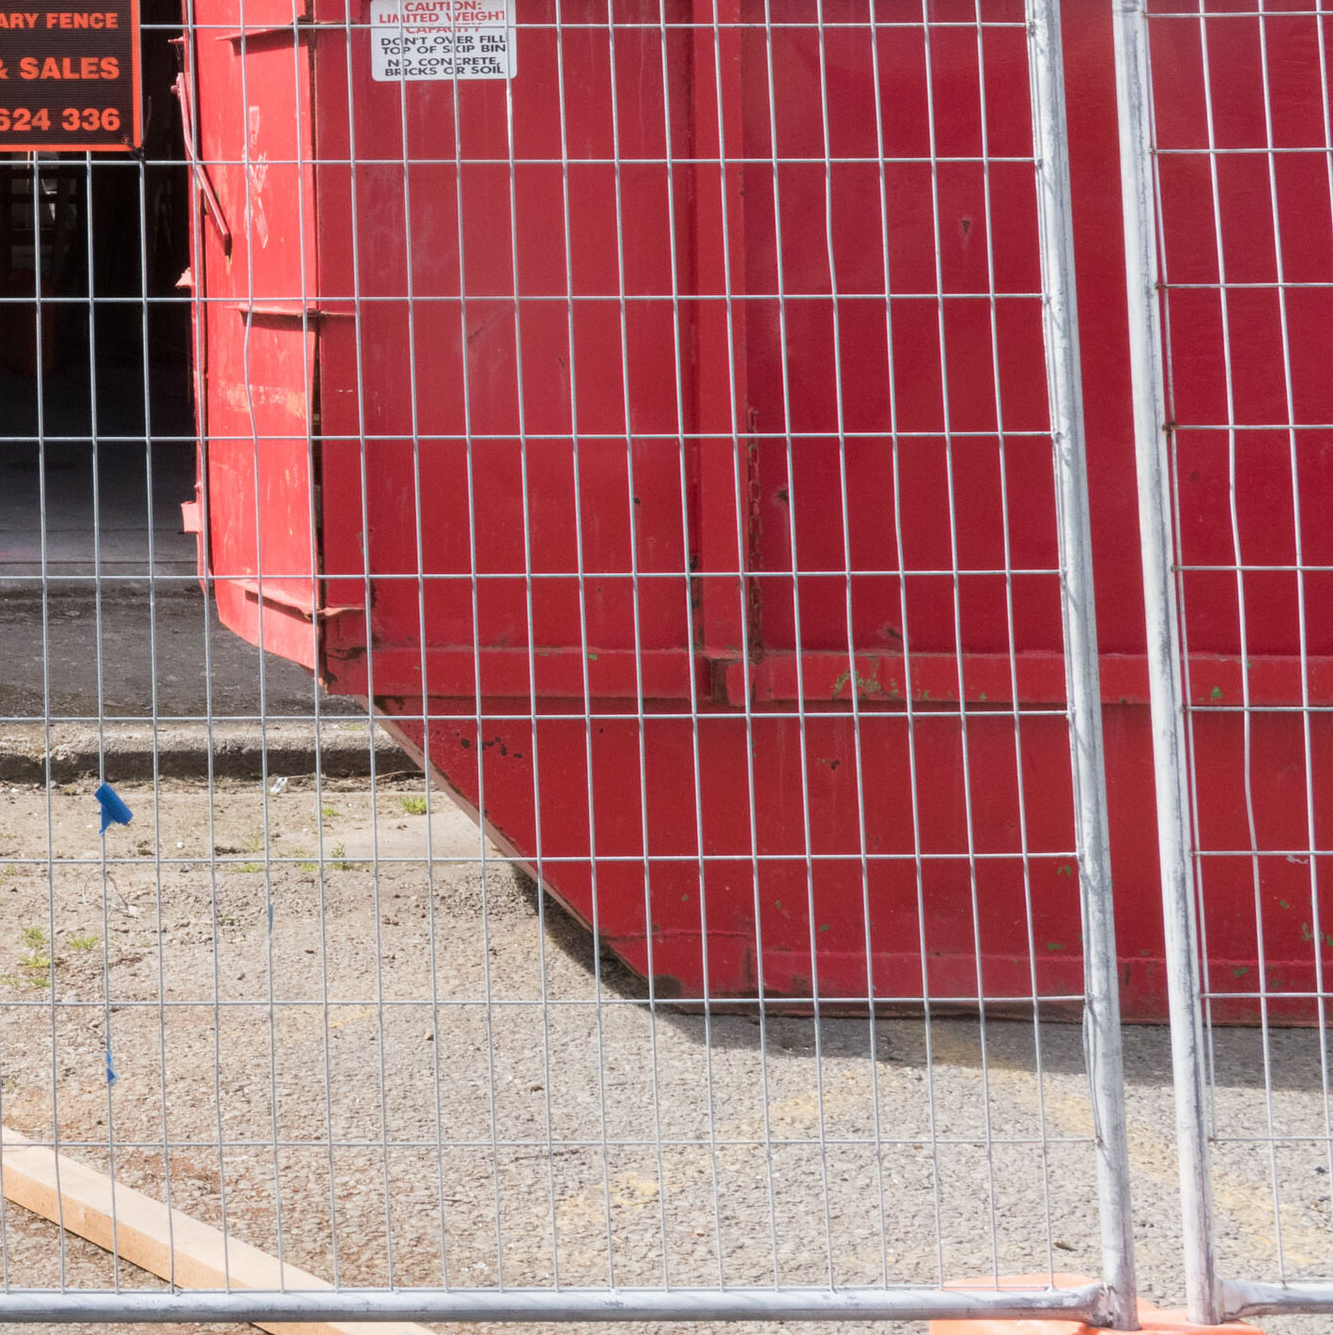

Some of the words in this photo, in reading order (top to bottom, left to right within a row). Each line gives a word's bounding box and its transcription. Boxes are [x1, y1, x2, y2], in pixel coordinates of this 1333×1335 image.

[404, 1, 482, 12] CAUTION:
[46, 12, 119, 30] FENCE
[379, 12, 440, 24] LIMITED
[381, 36, 428, 46] DON'T
[433, 35, 474, 45] OVER
[479, 35, 506, 44] FILL
[381, 46, 411, 55] TOP
[417, 46, 437, 54] OF
[481, 44, 506, 53] BIN
[387, 58, 412, 67] NO
[19, 57, 121, 81] SALES
[385, 67, 437, 77] BRICKS
[443, 66, 466, 75] OR
[471, 65, 504, 75] SOIL
[61, 108, 121, 132] 336
